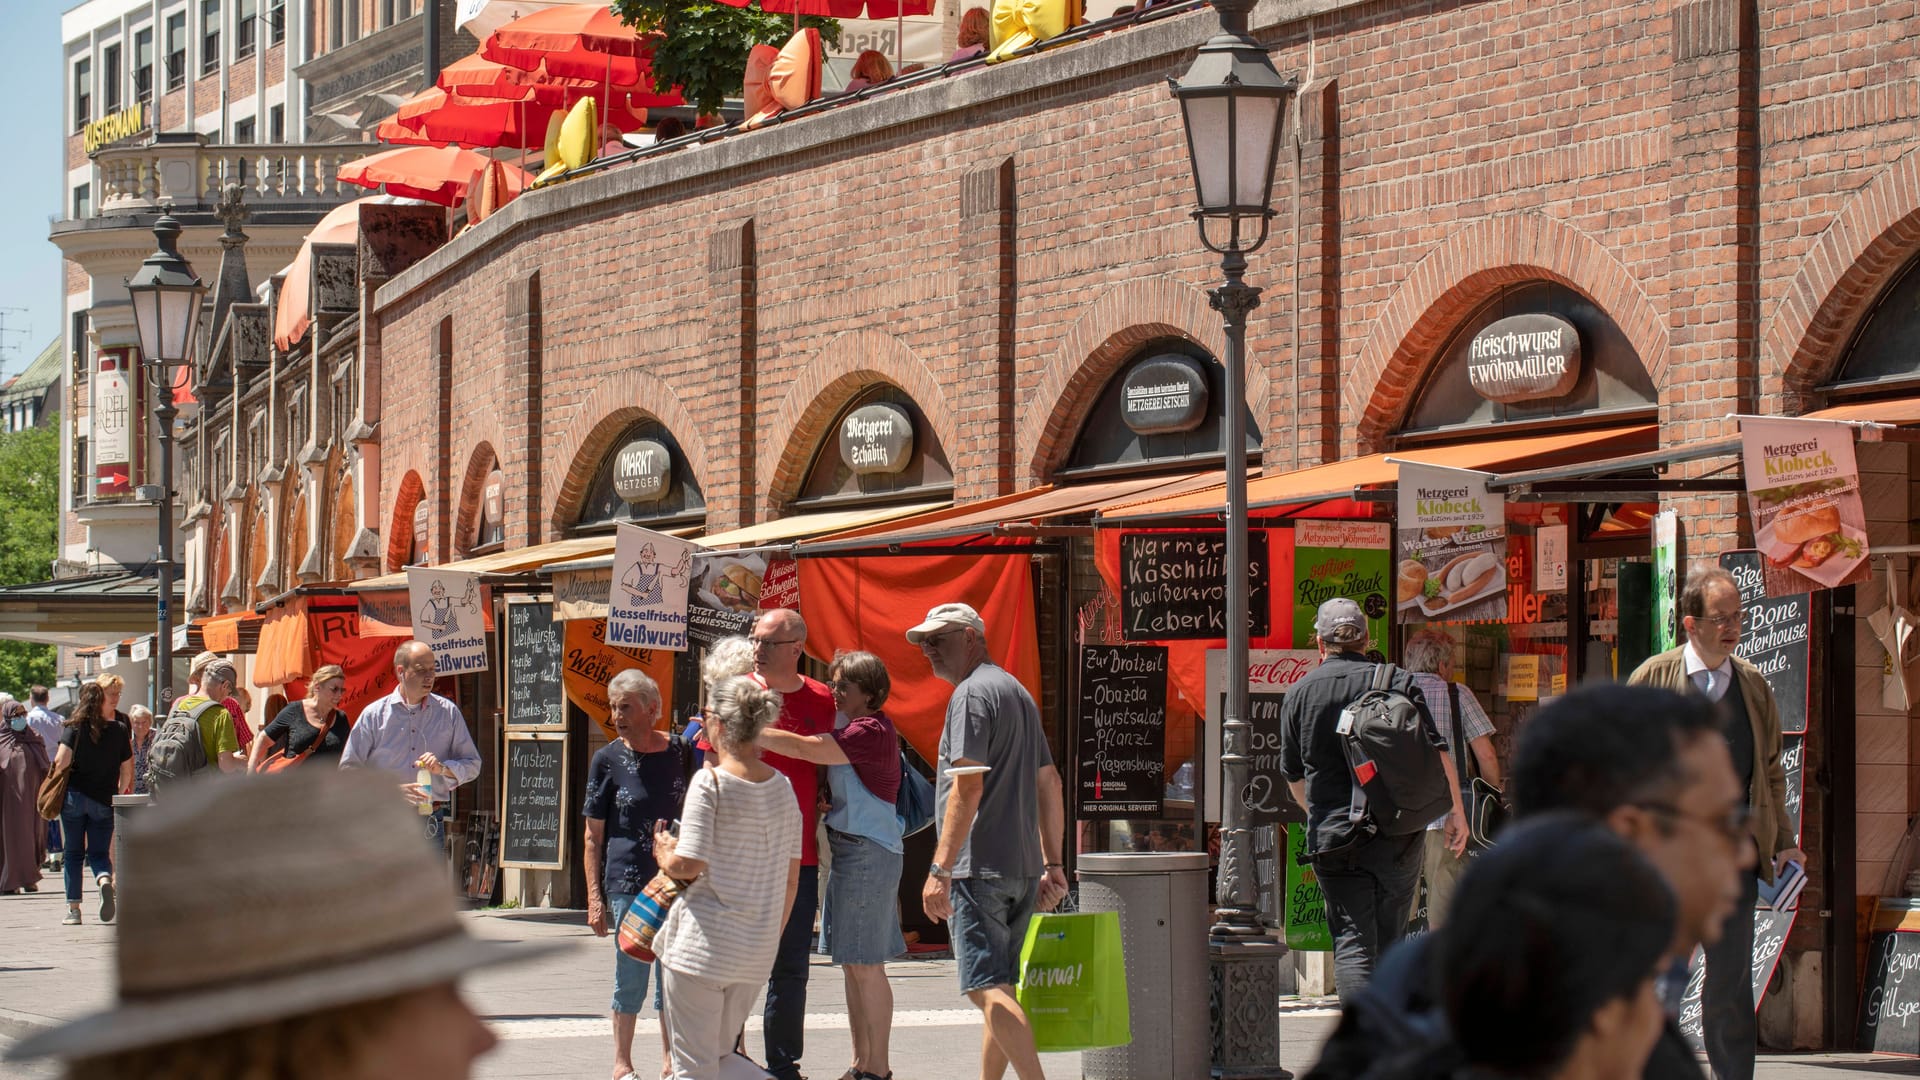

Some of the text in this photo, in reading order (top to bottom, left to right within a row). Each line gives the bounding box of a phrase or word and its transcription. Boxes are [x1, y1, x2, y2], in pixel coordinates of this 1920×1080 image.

[83, 101, 142, 154] KUSTERMANN
[1127, 397, 1163, 412] METZGEREI
[847, 414, 893, 443] Metzgerei
[1763, 437, 1818, 458] Metzgerei
[621, 449, 654, 478] MARKT
[1764, 449, 1835, 477] Klobeck
[616, 476, 660, 490] METZGER
[1767, 466, 1838, 484] Tradition seit 1929
[1416, 486, 1469, 501] Metzgerei
[1416, 498, 1483, 516] Klobeck
[1751, 502, 1784, 518] Warme
[1418, 515, 1452, 523] Tradition
[1467, 513, 1485, 521] 1929
[1402, 528, 1500, 552] Warme Wiener
[1421, 549, 1438, 558] zum
[1341, 571, 1385, 595] Steak
[611, 606, 688, 624] kesselfrische
[688, 604, 750, 623] JETZT FRISCH
[690, 615, 743, 631] GENIESSEN!
[430, 636, 484, 652] sselfrische
[609, 621, 688, 648] Weißwurst
[1734, 621, 1808, 658] orterhouse,
[434, 651, 487, 673] eißwurst
[1086, 649, 1109, 670] Zur
[512, 745, 558, 768] Krusten-
[520, 770, 554, 789] braten
[1083, 804, 1158, 812] HIER ORIGINAL SERVIERT!
[511, 811, 559, 832] Frikadelle
